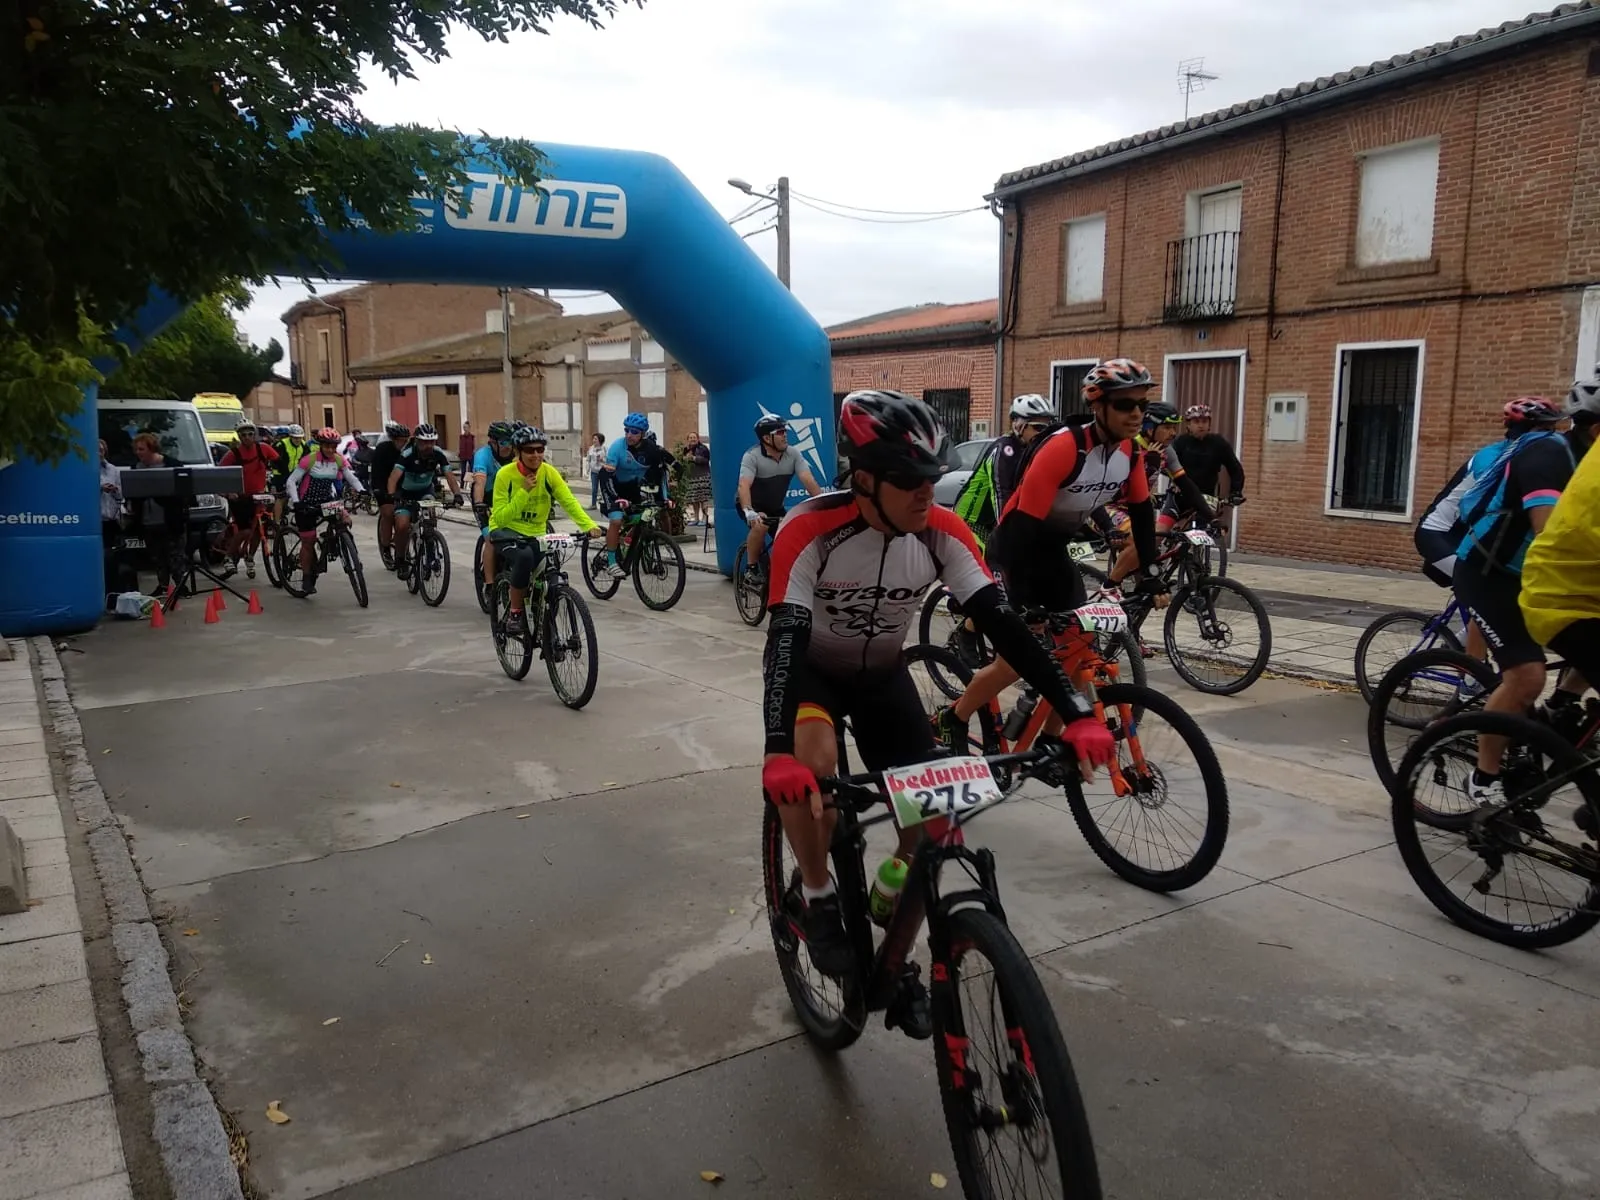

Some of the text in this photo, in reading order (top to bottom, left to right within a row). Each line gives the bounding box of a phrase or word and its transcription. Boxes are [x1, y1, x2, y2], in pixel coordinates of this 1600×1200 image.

[546, 539, 569, 551] 275
[1091, 615, 1120, 632] 277
[768, 688, 785, 729] CROSS
[886, 761, 990, 793] bedunia
[914, 782, 982, 818] 276
